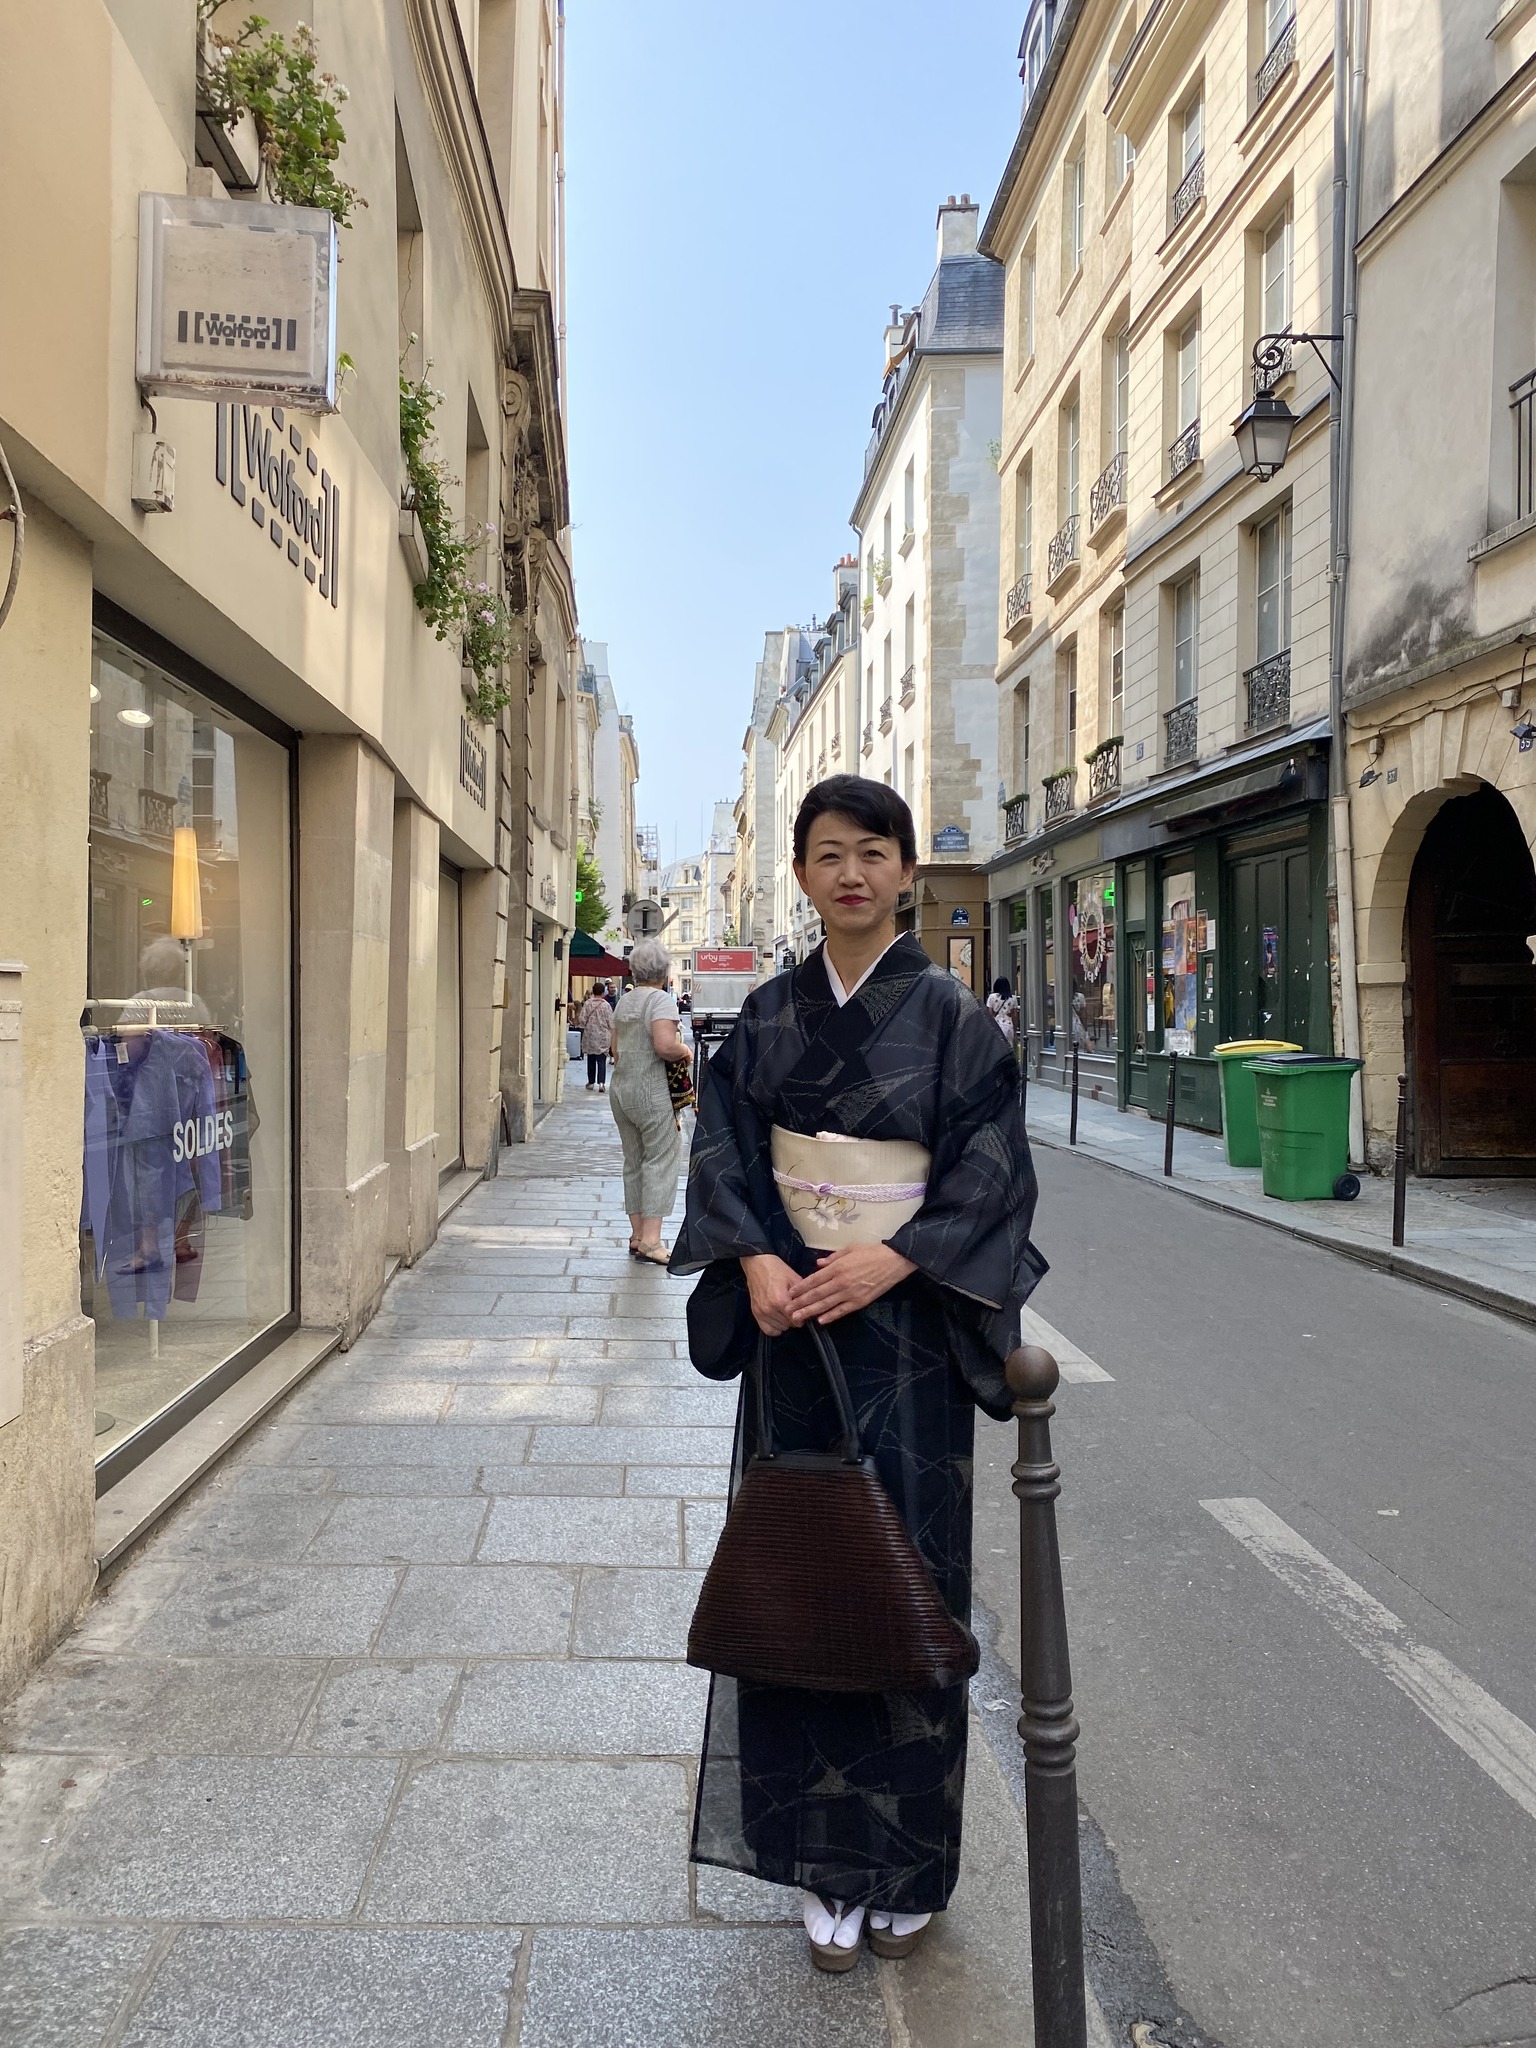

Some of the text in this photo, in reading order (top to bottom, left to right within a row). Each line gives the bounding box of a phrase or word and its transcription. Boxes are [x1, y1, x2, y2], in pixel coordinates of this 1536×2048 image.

[205, 320, 271, 341] Wolford
[243, 404, 323, 559] Wolford
[700, 952, 718, 963] urby
[173, 1110, 234, 1163] SOLDES
